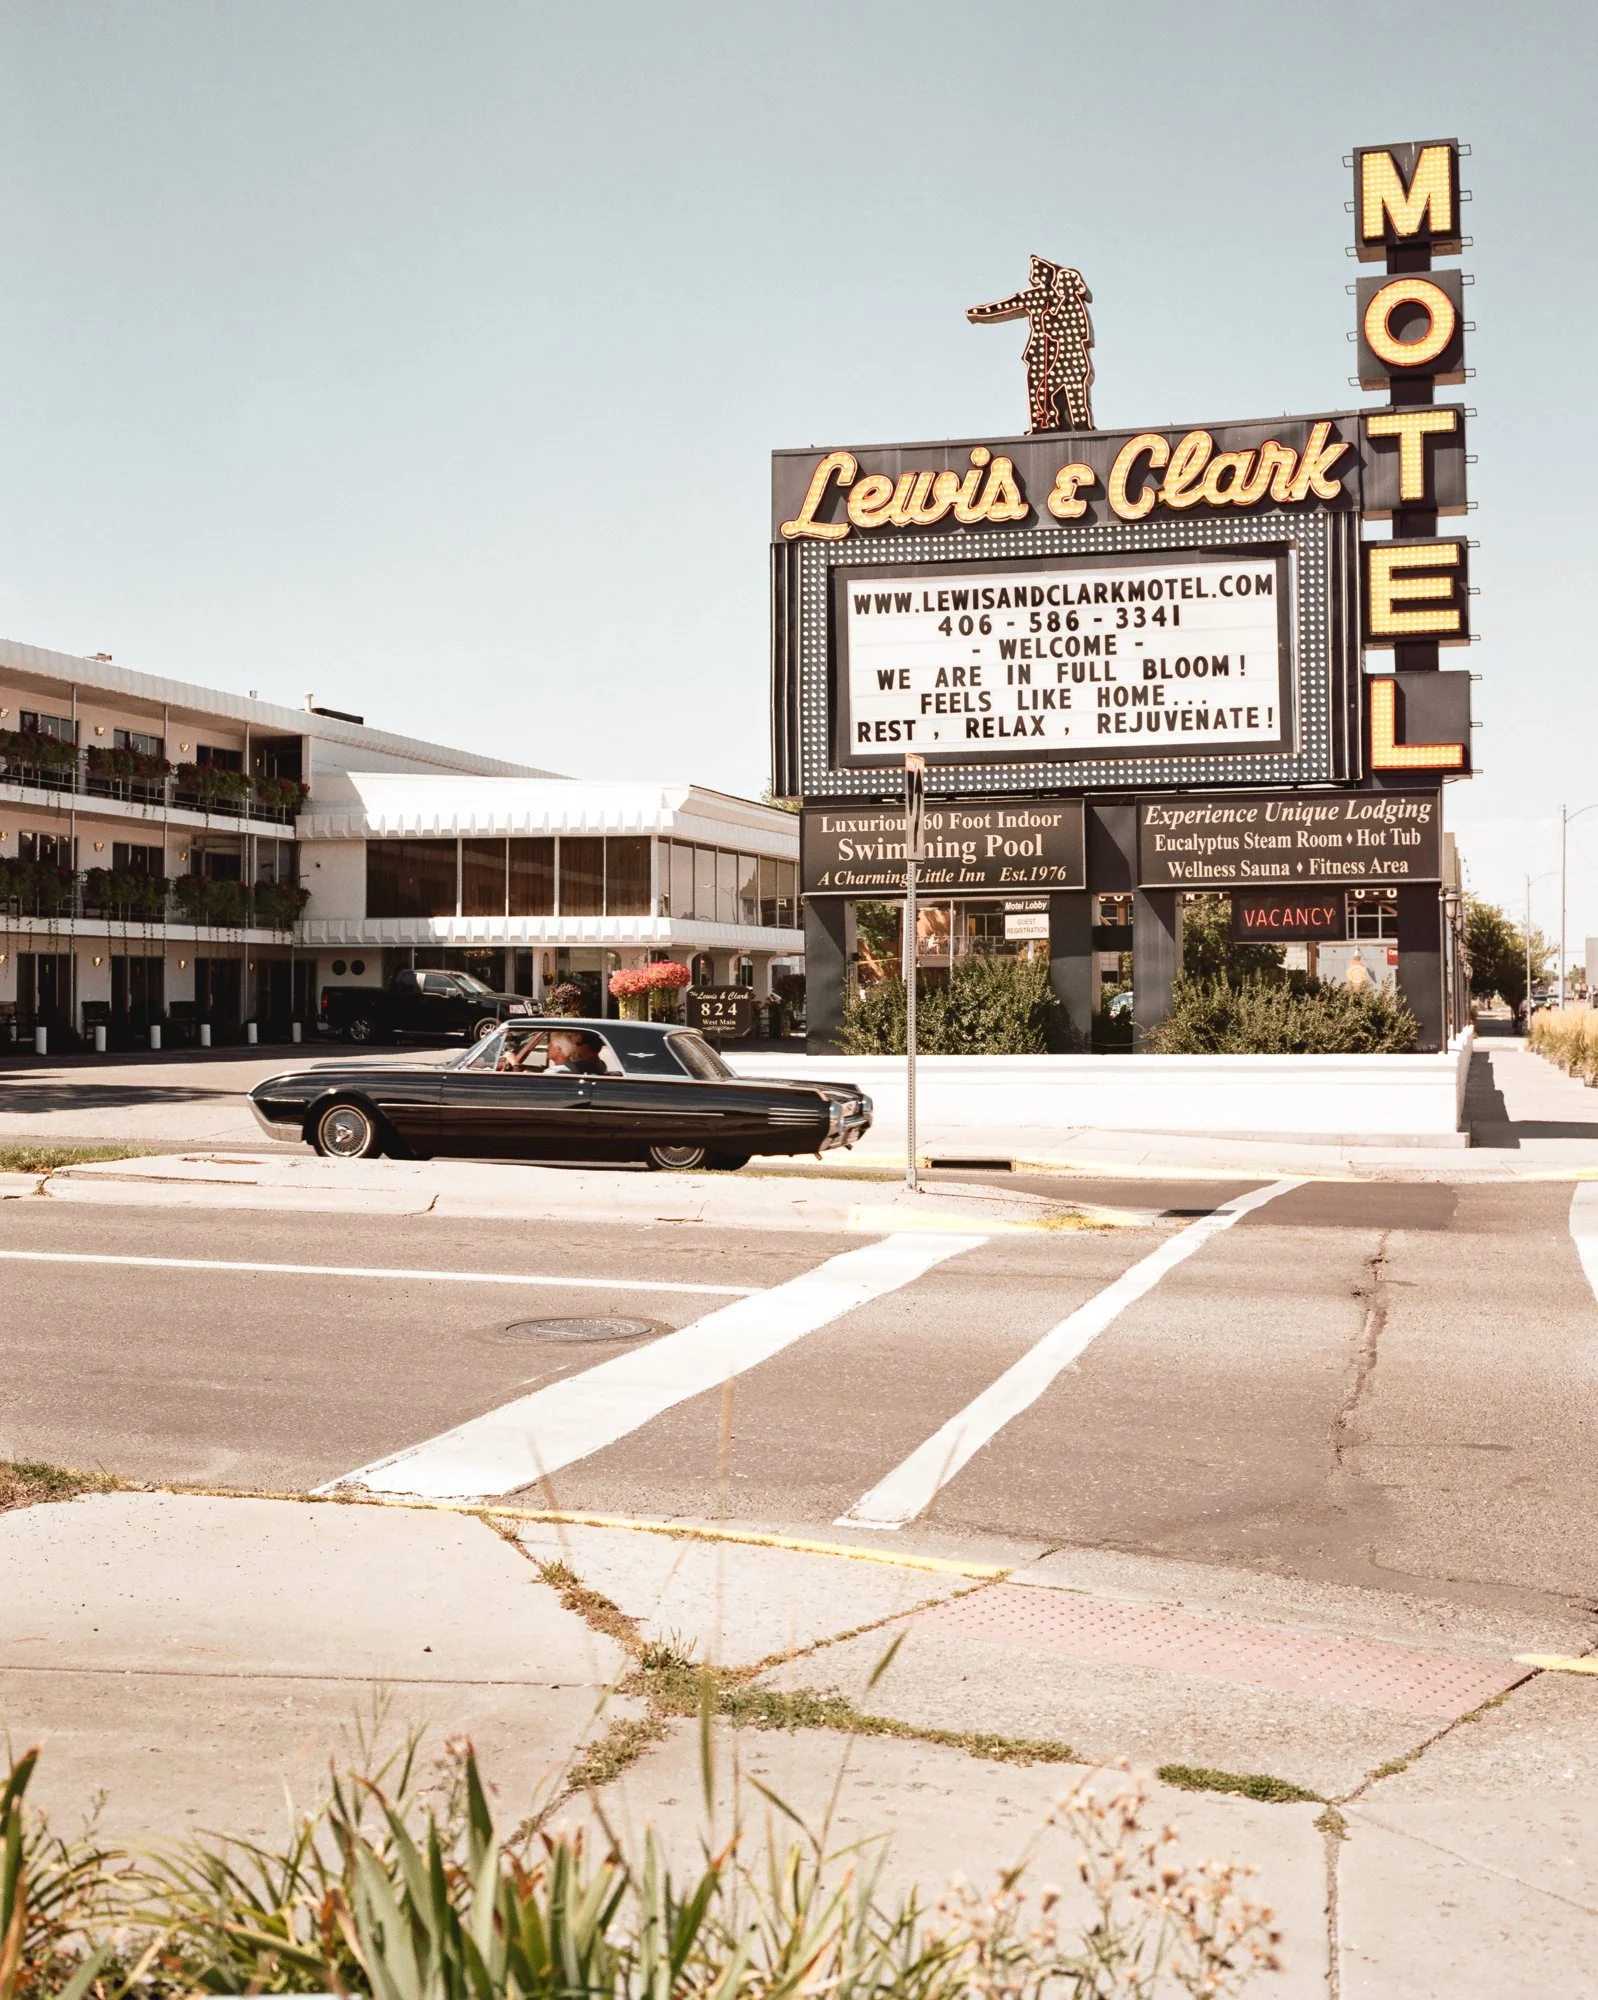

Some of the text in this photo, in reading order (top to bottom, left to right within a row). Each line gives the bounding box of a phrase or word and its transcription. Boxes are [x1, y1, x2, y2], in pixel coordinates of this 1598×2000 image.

[1360, 144, 1464, 769] MOTEL
[780, 421, 1352, 540] Lewis & Clark
[853, 573, 1273, 615] WWW.LEWISANDCLARKMOTEL.COM
[998, 633, 1118, 660] WELCOME
[876, 654, 1246, 691] WE ARE IN FULL BLOOM!
[920, 690, 992, 715] FEELS
[1017, 688, 1072, 711] LIKE
[1097, 706, 1274, 734] REJUVENATE!
[821, 814, 907, 833] Luxuriou
[949, 812, 992, 830] Foot
[996, 811, 1063, 828] Indoor
[1144, 798, 1432, 830] Experience Unique Lodging
[984, 833, 1043, 857] Pool
[1154, 827, 1421, 855] Eucalyptus Steam Room Hot Tub
[817, 866, 1067, 888] A Charming Little Inn Est.1976
[1167, 857, 1409, 878] Wellness Sauna Fitness Area
[1004, 901, 1047, 910] Motel Lobby
[1244, 907, 1336, 928] VACANCY
[701, 1002, 737, 1016] 824
[727, 992, 748, 1000] Clark
